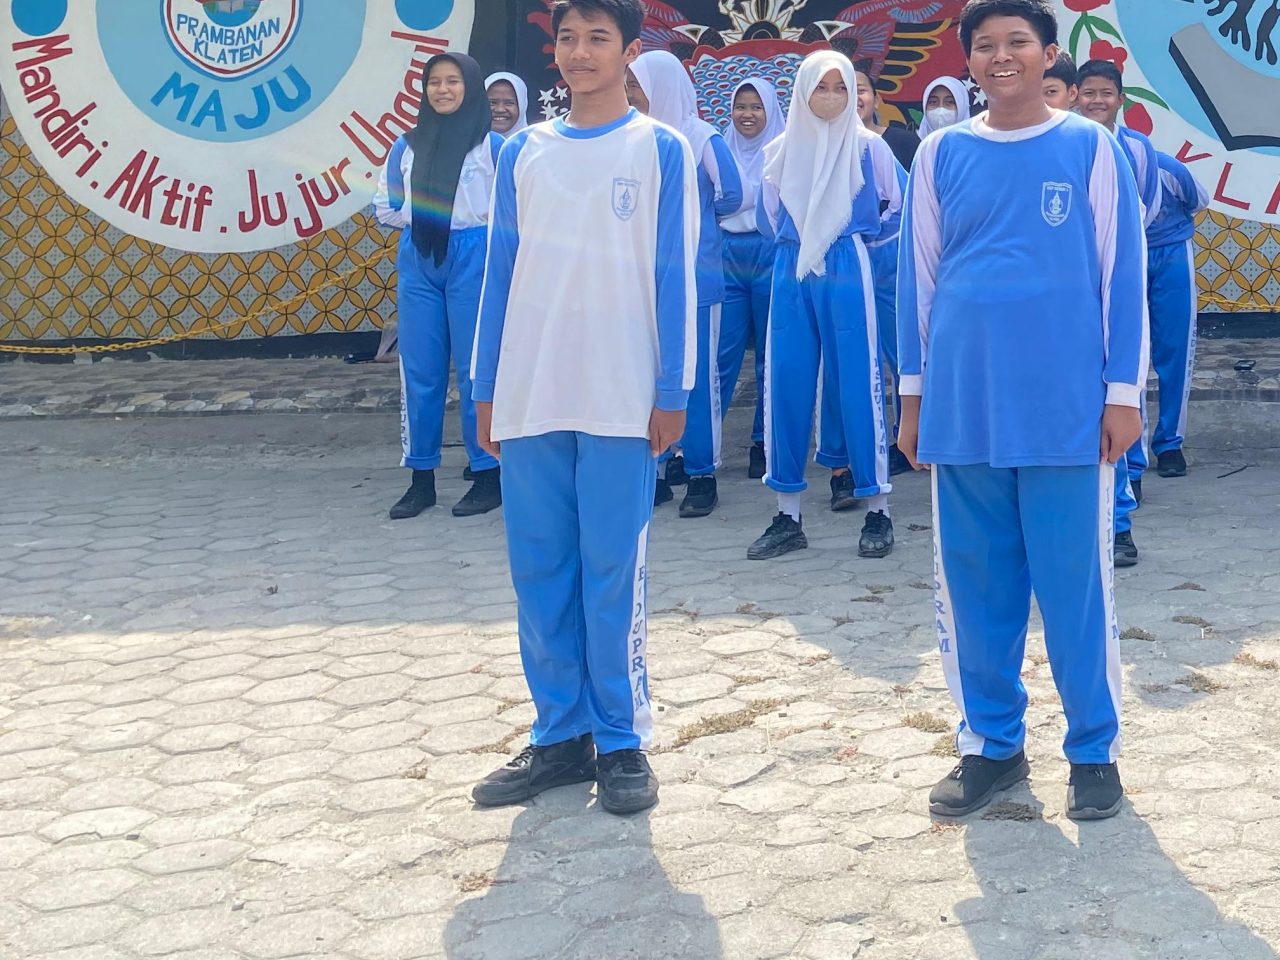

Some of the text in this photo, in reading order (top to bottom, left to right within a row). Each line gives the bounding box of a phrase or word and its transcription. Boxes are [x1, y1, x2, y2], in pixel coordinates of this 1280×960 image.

[176, 13, 281, 46] PRAMBANAN
[193, 36, 263, 65] KLATEN
[150, 64, 312, 132] MAJU
